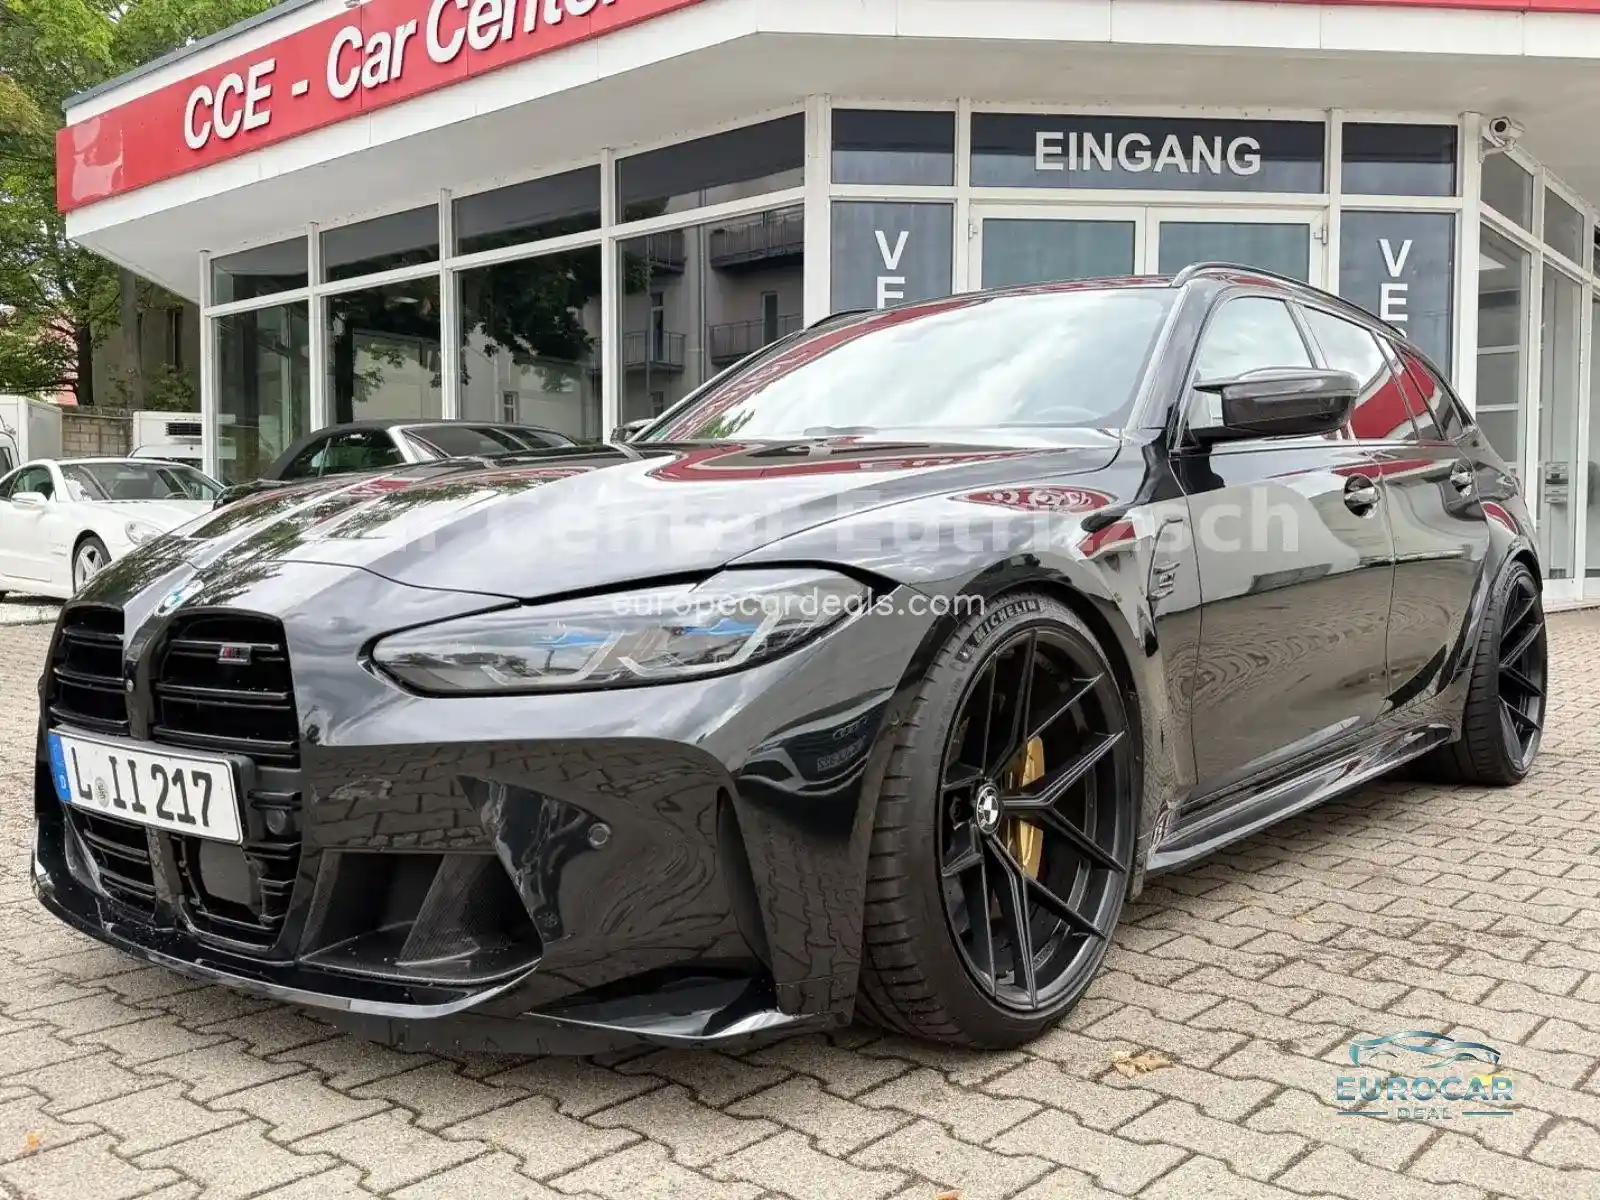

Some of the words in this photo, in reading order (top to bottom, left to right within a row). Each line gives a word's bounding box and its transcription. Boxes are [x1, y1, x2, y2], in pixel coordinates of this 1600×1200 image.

[184, 57, 276, 150] CCE
[327, 19, 418, 100] Car
[1034, 131, 1262, 175] EINGANG
[1379, 238, 1413, 338] VE
[971, 599, 1039, 645] MICHELIN
[70, 746, 93, 801] L
[151, 763, 213, 828] 217
